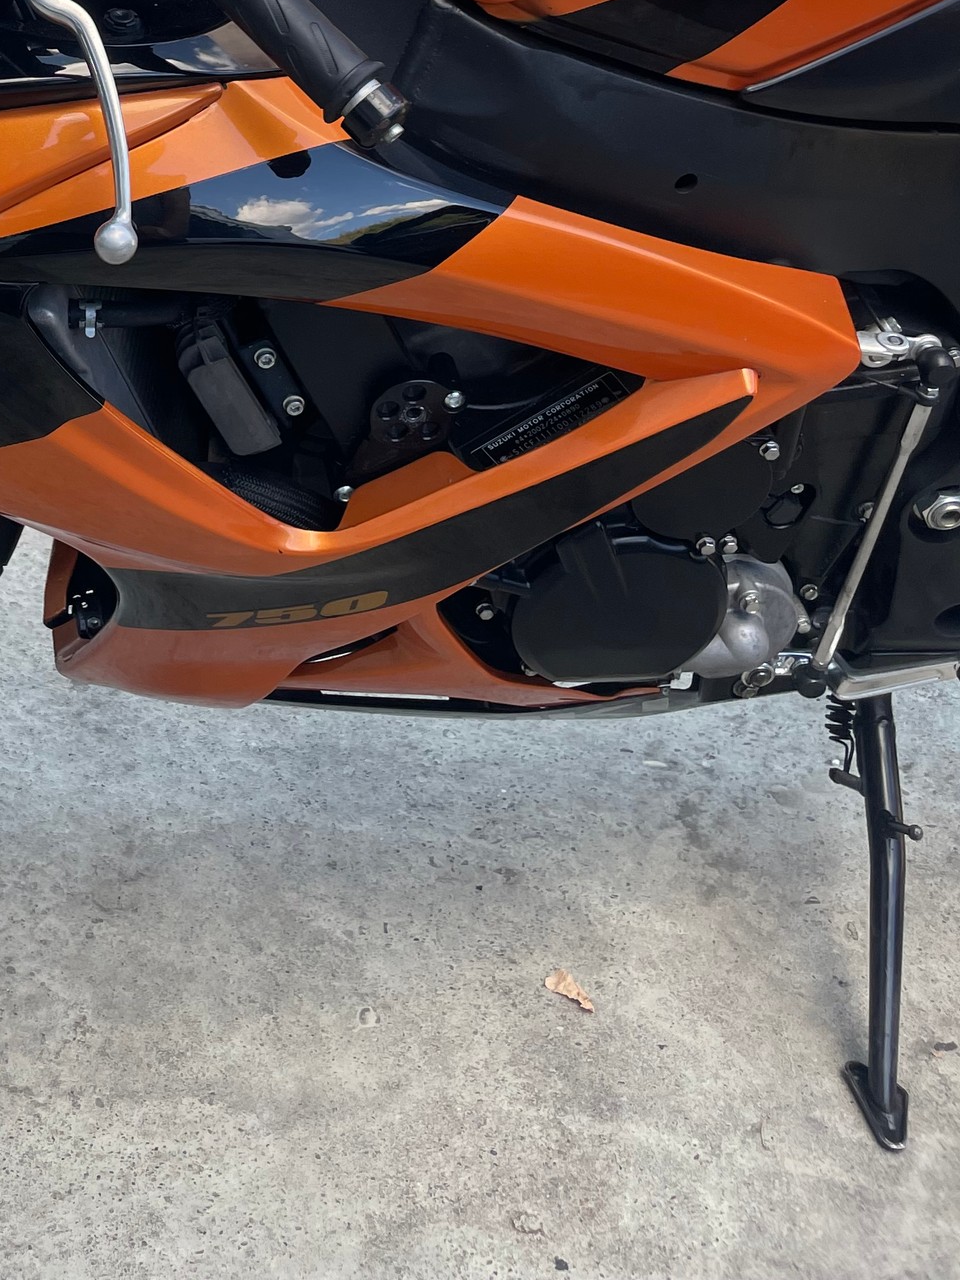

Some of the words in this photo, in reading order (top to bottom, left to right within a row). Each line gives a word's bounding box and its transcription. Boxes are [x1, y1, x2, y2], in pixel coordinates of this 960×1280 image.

[487, 431, 516, 451] SUZUKI
[517, 415, 545, 433] MOTOR
[545, 383, 600, 417] CORPORATION
[206, 590, 389, 628] 750
